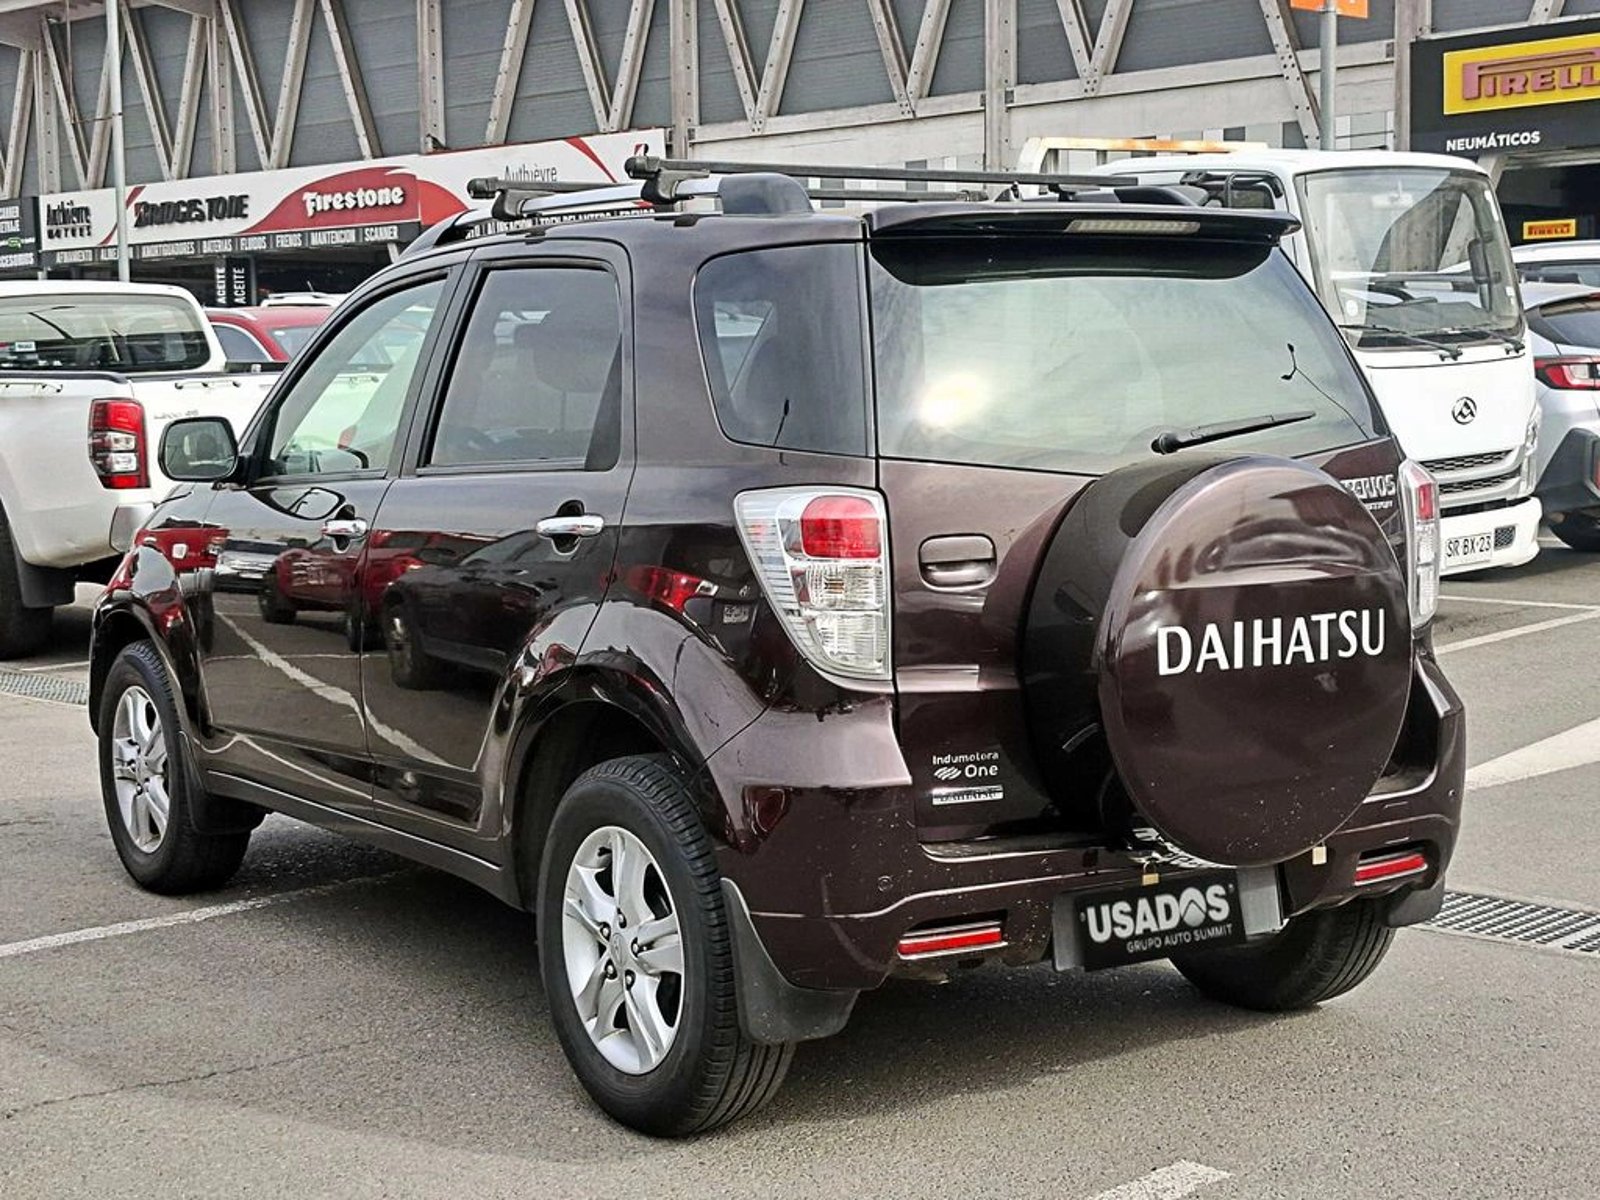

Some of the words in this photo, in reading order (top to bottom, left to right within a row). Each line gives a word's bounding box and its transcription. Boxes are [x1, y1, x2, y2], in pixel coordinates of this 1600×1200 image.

[1446, 131, 1541, 152] NEUMÁTICOS
[134, 194, 250, 228] BRIDGESTONE
[302, 186, 404, 217] Firestone
[215, 266, 227, 304] ACEITE
[233, 266, 246, 304] ACEITE
[1157, 608, 1385, 676] DAIHATSU
[964, 763, 999, 778] One
[1086, 884, 1231, 943] USADOS
[1126, 936, 1163, 954] GRUPO
[1163, 929, 1192, 947] AUTO
[1193, 923, 1233, 942] SUMMIT
